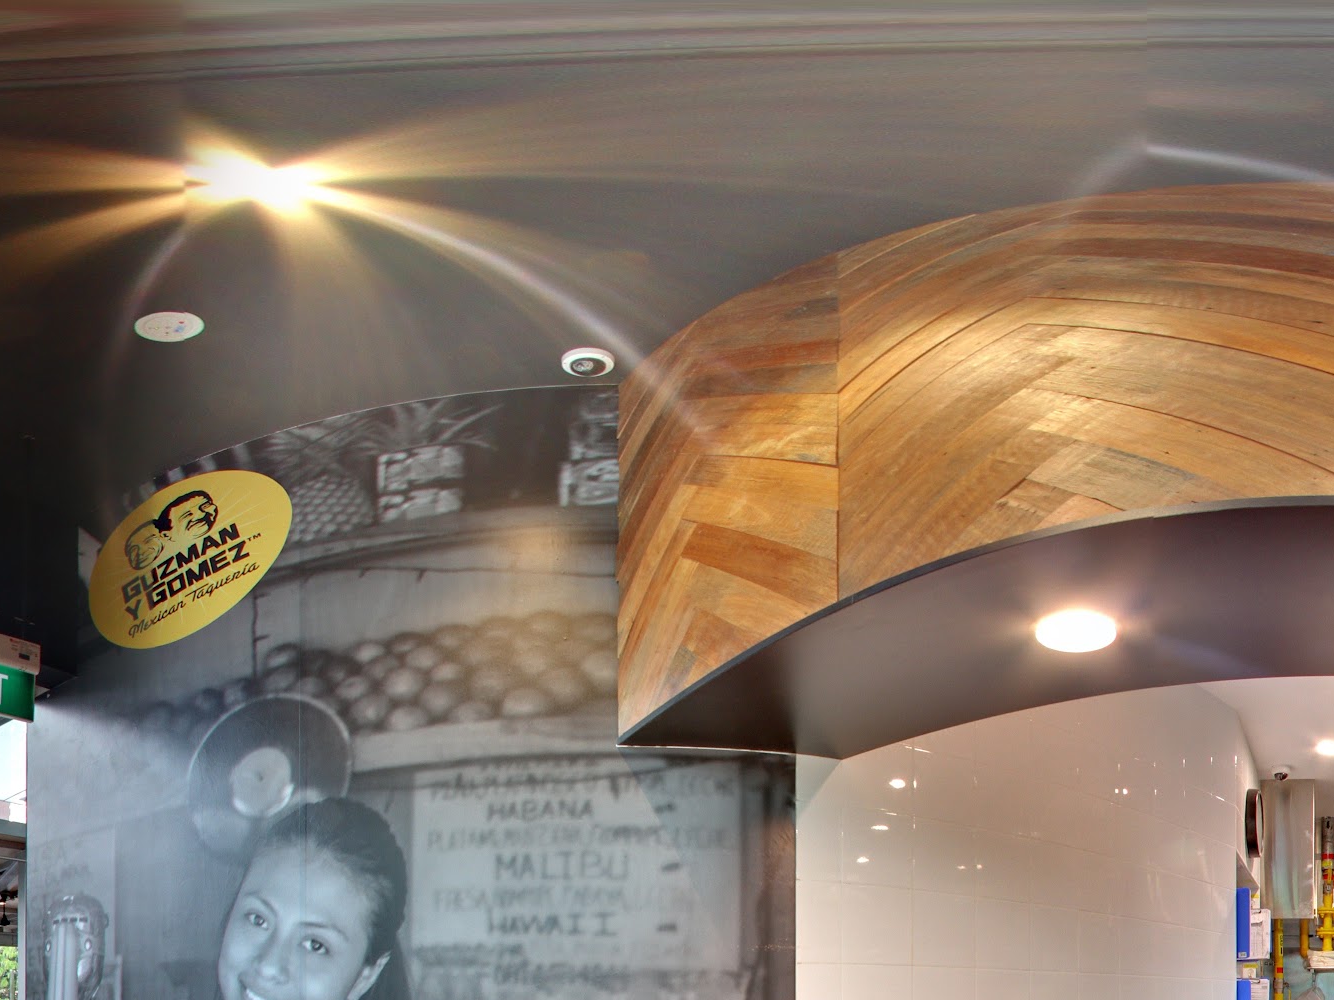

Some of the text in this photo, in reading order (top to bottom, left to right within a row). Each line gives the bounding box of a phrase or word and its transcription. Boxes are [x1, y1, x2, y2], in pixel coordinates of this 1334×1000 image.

[121, 523, 240, 604] GUZMAN
[125, 599, 144, 621] Y
[148, 540, 250, 611] GOMEZ
[128, 600, 187, 638] Mexican
[494, 852, 629, 880] MALIBU
[486, 911, 618, 937] HAWAII
